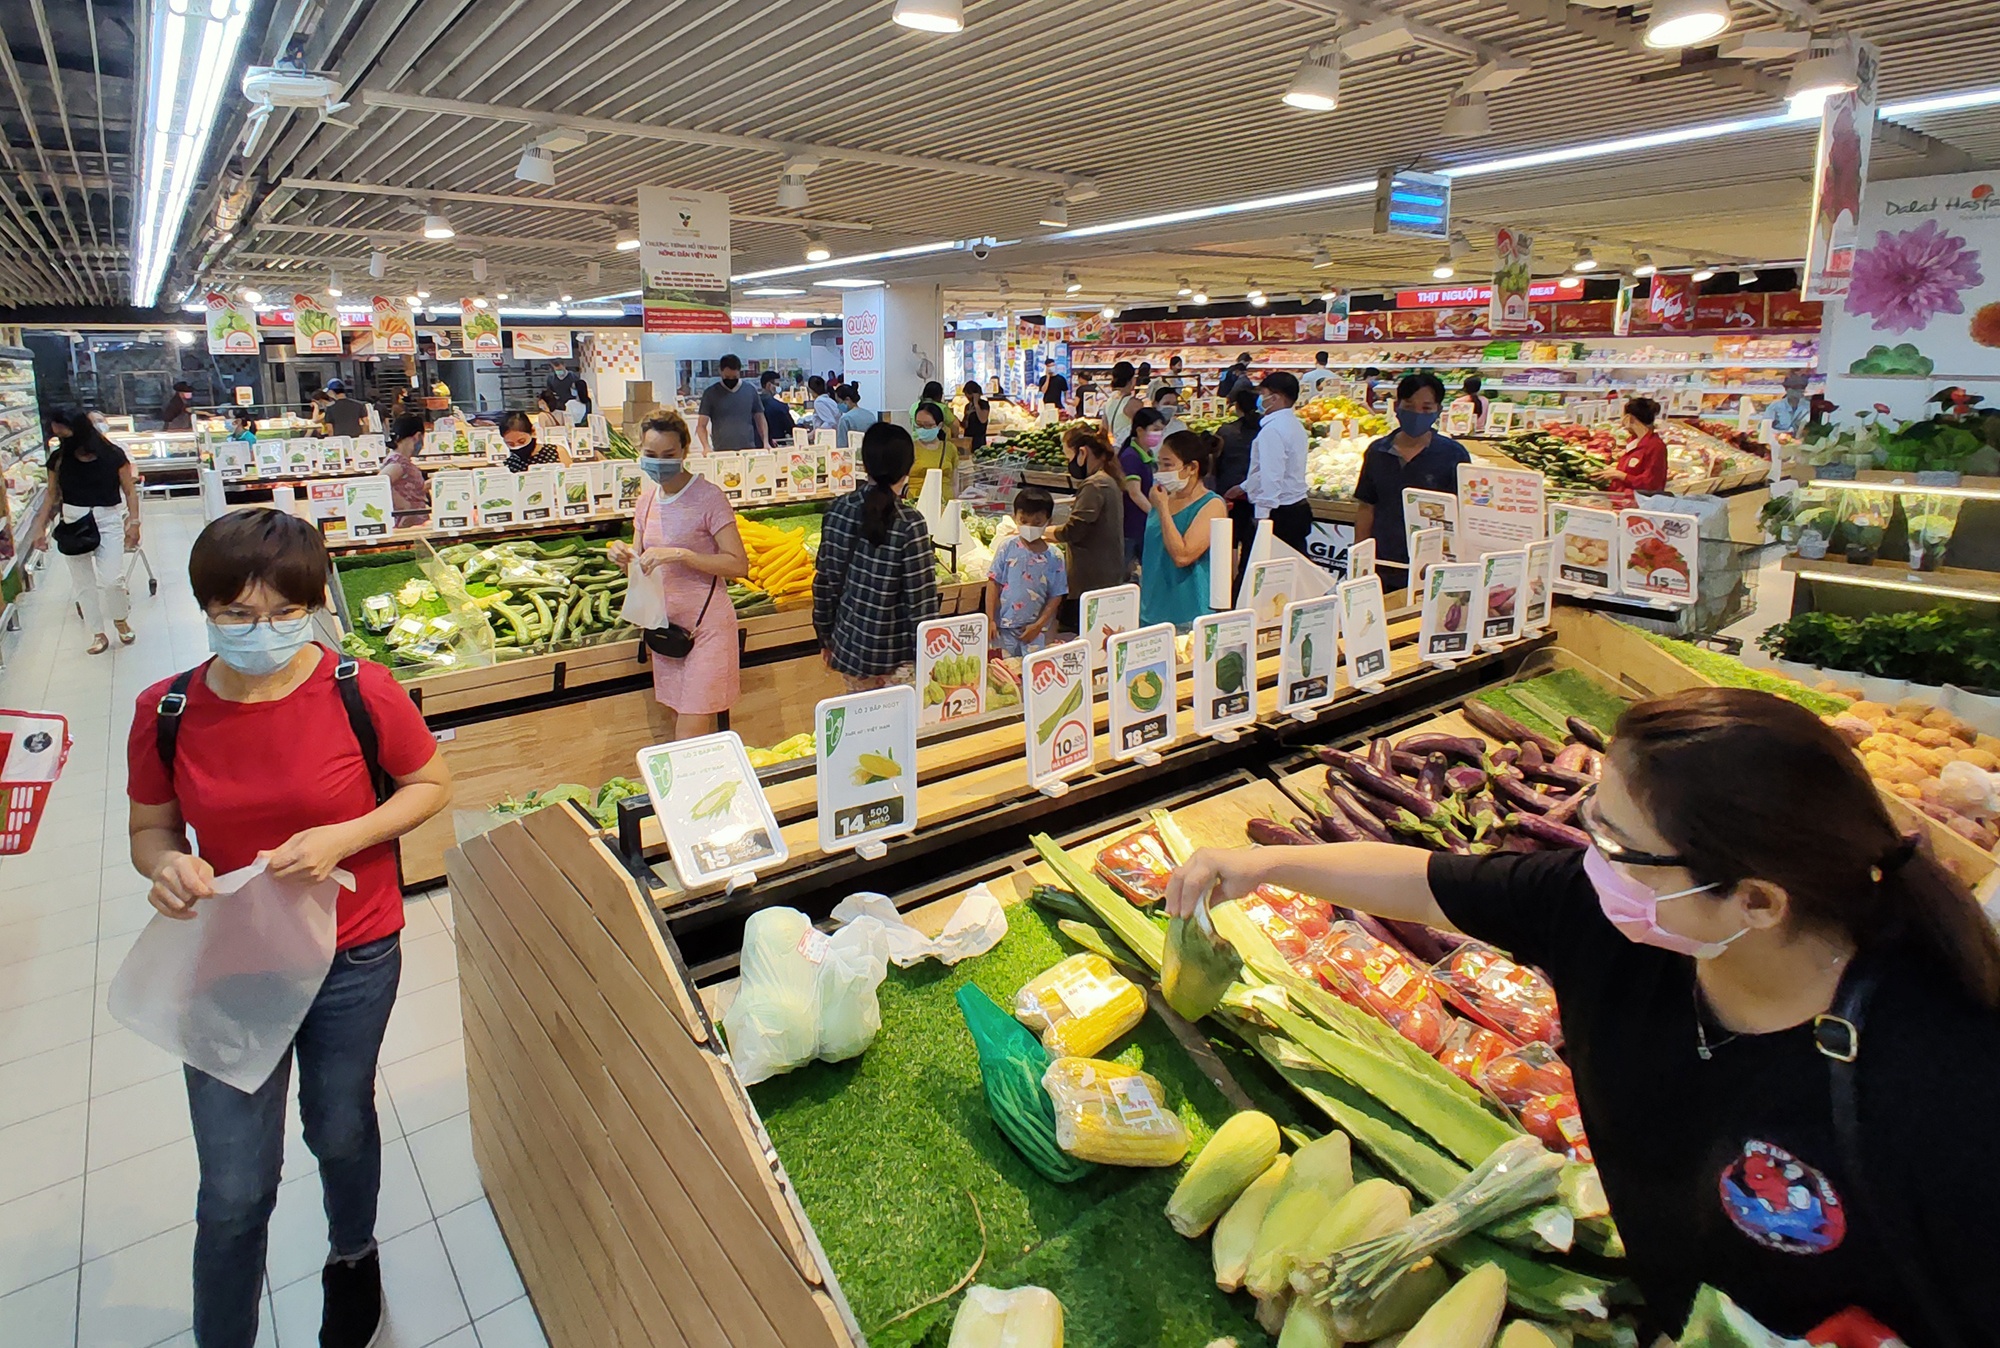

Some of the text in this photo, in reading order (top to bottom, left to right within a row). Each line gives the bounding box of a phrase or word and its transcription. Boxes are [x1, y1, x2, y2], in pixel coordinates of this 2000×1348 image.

[1886, 197, 1938, 216] Dalat
[691, 251, 703, 259] VIỆT
[1418, 292, 1440, 303] THỊT
[1442, 287, 1478, 302] NGUỘI
[1652, 575, 1669, 588] 15
[1294, 687, 1307, 702] 17
[945, 699, 962, 717] 12
[1218, 703, 1228, 718] 8
[1056, 738, 1072, 757] 10
[1126, 729, 1142, 748] 18
[840, 813, 866, 836] 14
[701, 847, 731, 870] 15
